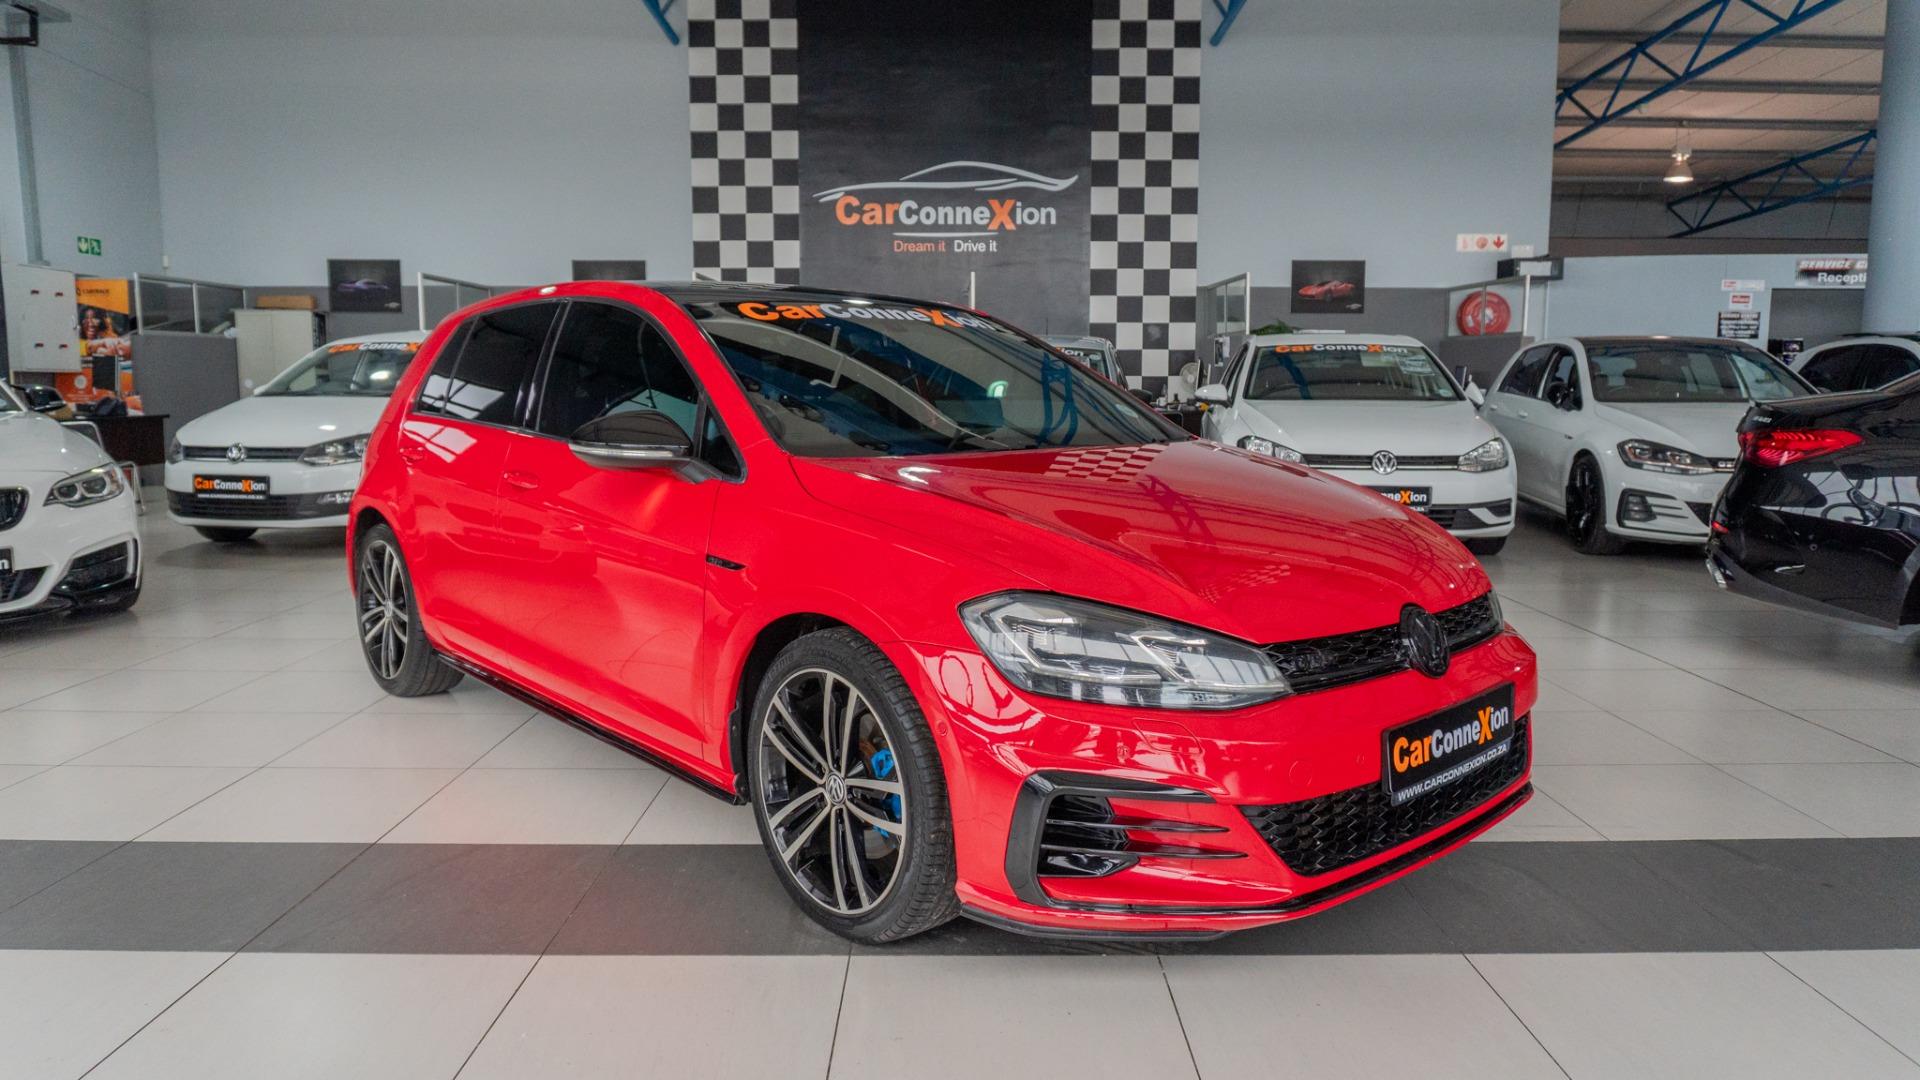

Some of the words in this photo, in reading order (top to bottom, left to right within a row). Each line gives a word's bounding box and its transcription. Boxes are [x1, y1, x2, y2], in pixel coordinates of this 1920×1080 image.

[835, 195, 1057, 231] CarConneXion
[893, 240, 935, 252] Dream
[938, 240, 946, 252] it
[953, 240, 987, 252] Drive
[989, 240, 997, 252] it
[1817, 272, 1867, 284] Recepti
[737, 302, 996, 331] CarConneXion
[1275, 343, 1408, 354] CarConneXion
[193, 476, 266, 493] CarConneXion
[1393, 705, 1509, 774] CarConneXion
[1397, 743, 1508, 802] WWW.CARCONNEXION.CO.ZA
